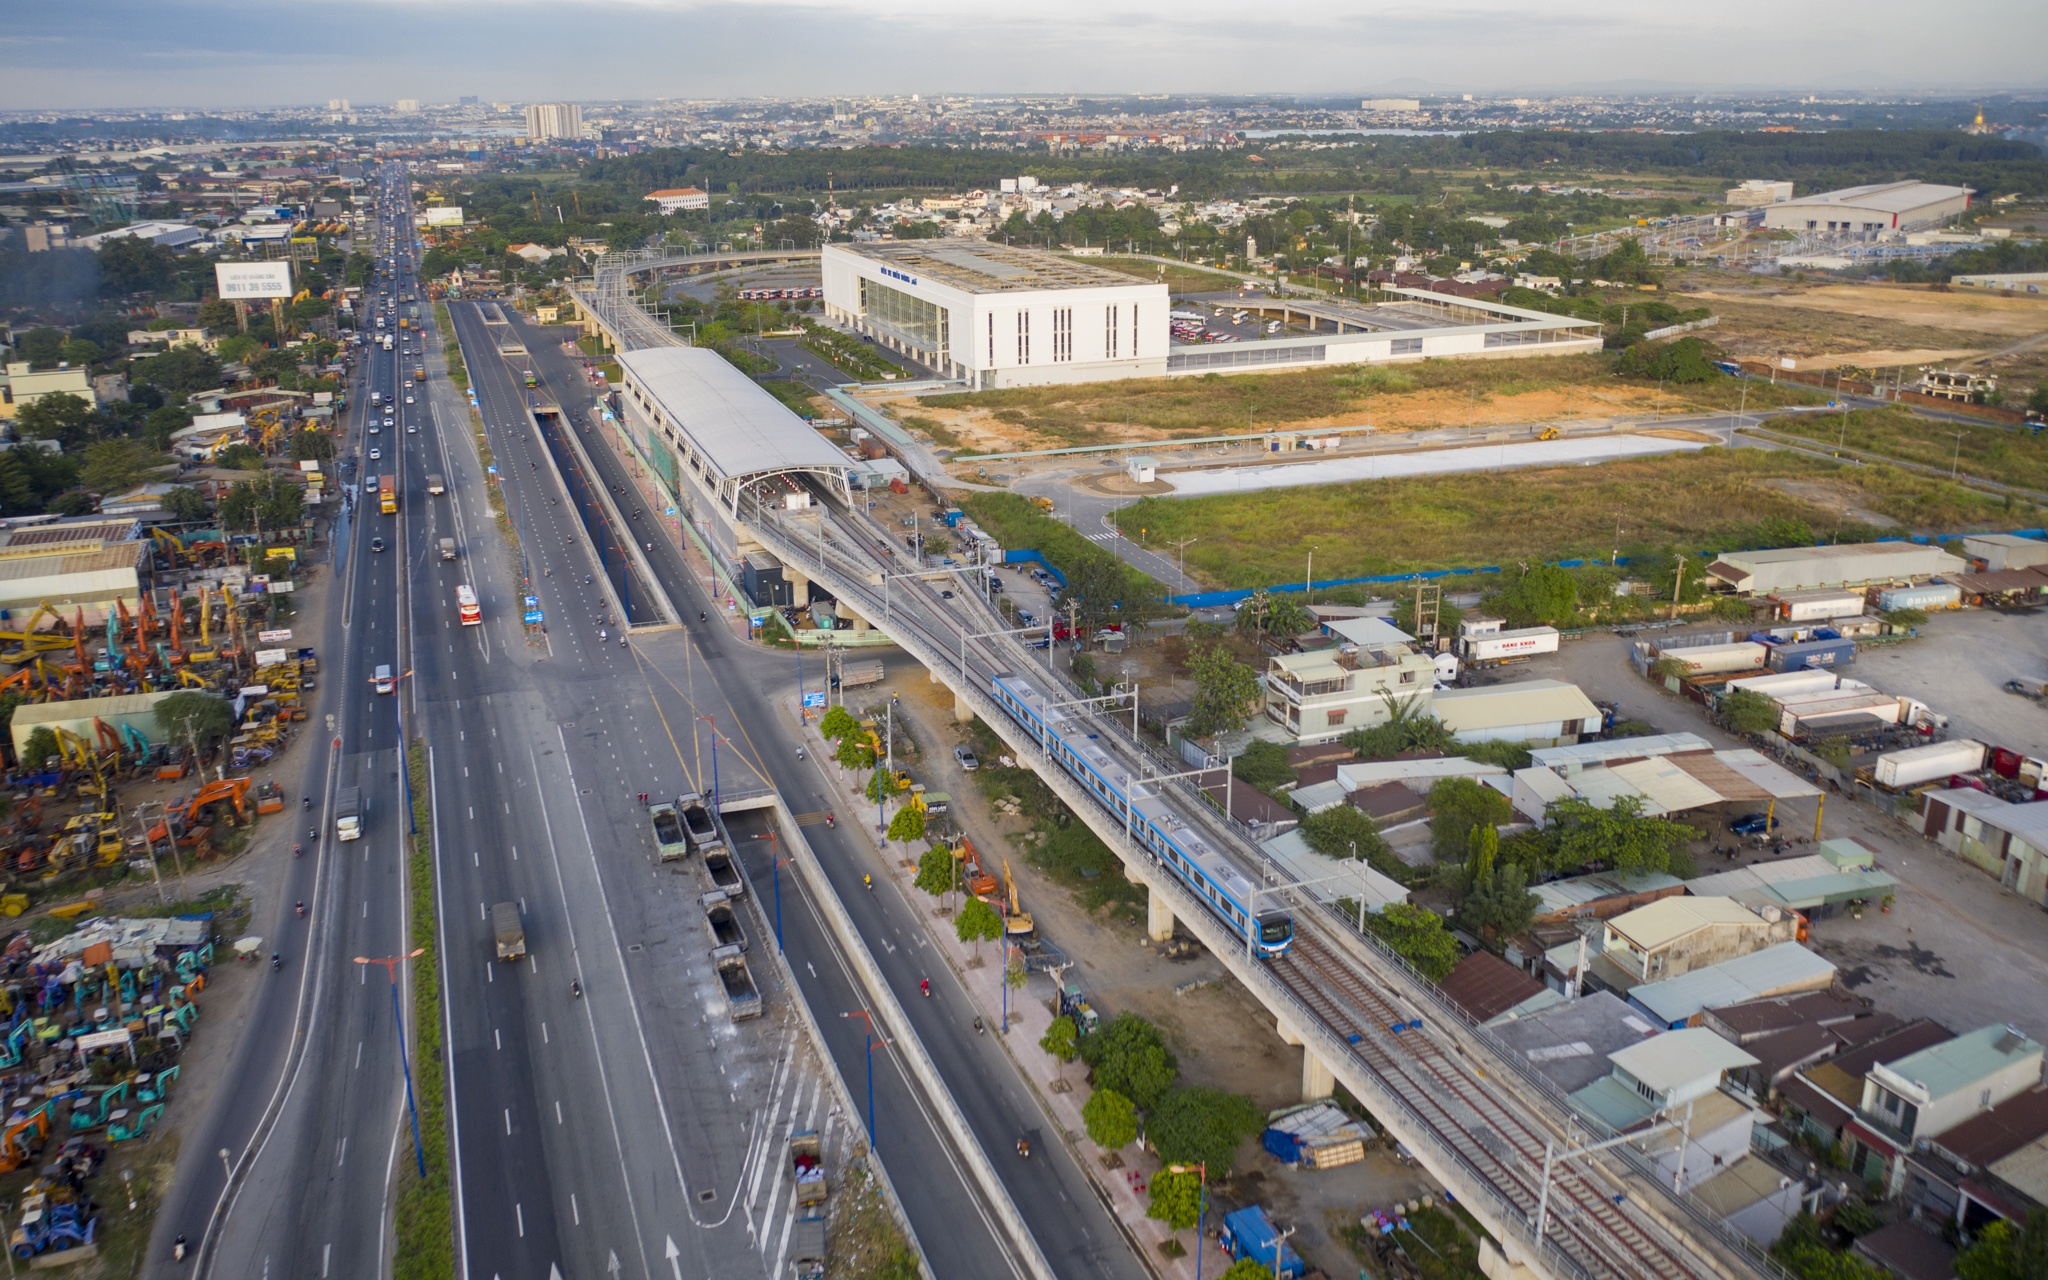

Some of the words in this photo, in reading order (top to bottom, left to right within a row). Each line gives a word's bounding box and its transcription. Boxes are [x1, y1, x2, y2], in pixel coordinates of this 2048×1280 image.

[225, 283, 246, 291] 0911
[248, 282, 260, 291] 39
[261, 282, 283, 291] 5555
[1914, 595, 1947, 604] HANJIN
